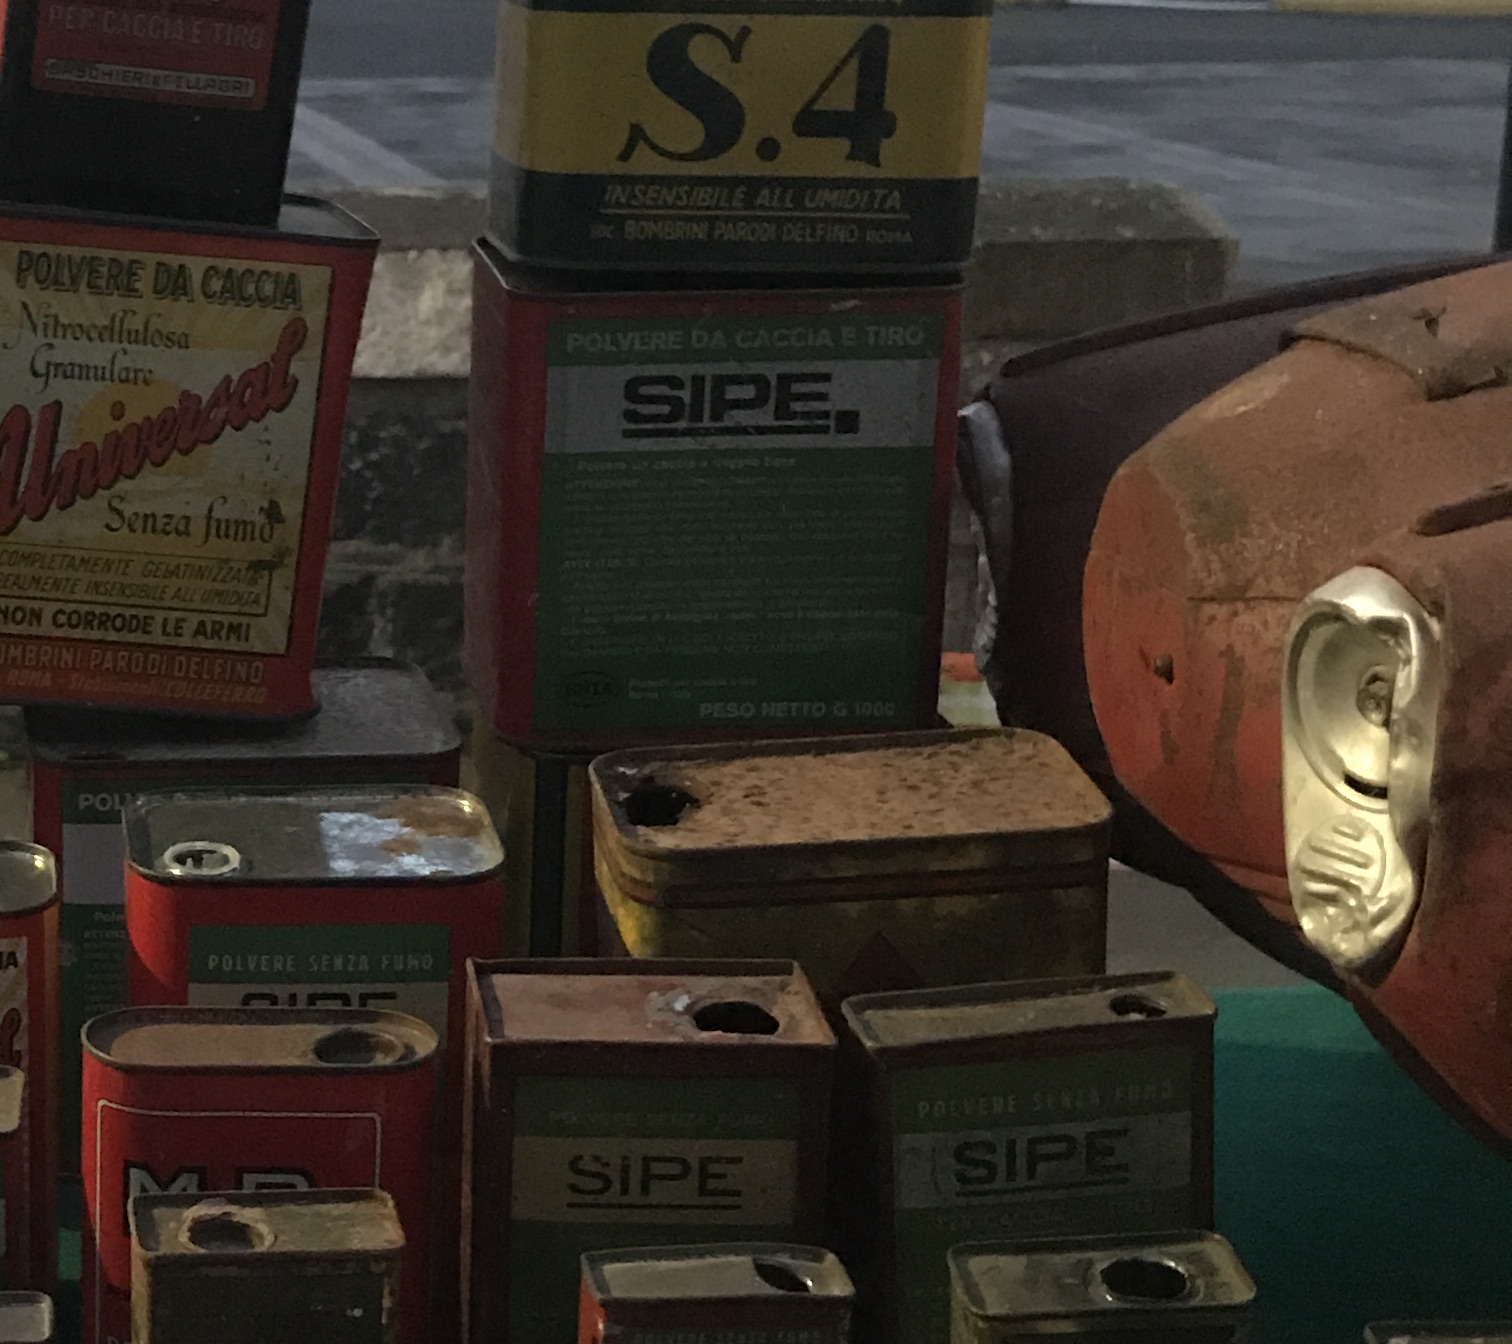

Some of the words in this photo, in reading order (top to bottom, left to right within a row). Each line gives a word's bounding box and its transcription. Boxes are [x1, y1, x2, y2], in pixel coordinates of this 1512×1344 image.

[49, 5, 94, 32] PER
[103, 10, 186, 43] CACCIA
[212, 21, 264, 50] TIRO
[616, 22, 897, 168] S.4
[604, 185, 745, 208] INSENSIBILE
[624, 221, 707, 240] BOMBRINI
[714, 222, 777, 241] PARODI
[783, 224, 859, 242] DELFINO
[15, 249, 145, 298] POLVERE
[153, 263, 194, 302] DA
[200, 266, 302, 311] CACCIA
[4, 301, 191, 350] Nitrocellulosa
[566, 329, 683, 354] POLVERE
[690, 329, 727, 350] DA
[735, 328, 834, 350] CACCIA
[840, 327, 857, 346] E
[864, 324, 926, 346] TIRO
[30, 344, 155, 393] Granulare
[106, 495, 193, 538] Senza
[195, 496, 277, 548] fumo
[86, 579, 168, 600] INSENSIBILE
[52, 608, 154, 635] CORRODE
[162, 618, 185, 637] LE
[193, 620, 250, 642] ARMI
[90, 649, 167, 676] PARODI
[173, 655, 264, 684] DELFINO
[699, 702, 756, 719] PESO
[761, 701, 827, 718] NETTO
[833, 702, 848, 717] G
[207, 955, 296, 972] POLVERE
[307, 955, 369, 972] SENZA
[381, 954, 433, 971] FUMO
[953, 1128, 1129, 1185] SIPE
[567, 1155, 744, 1197] SIPE
